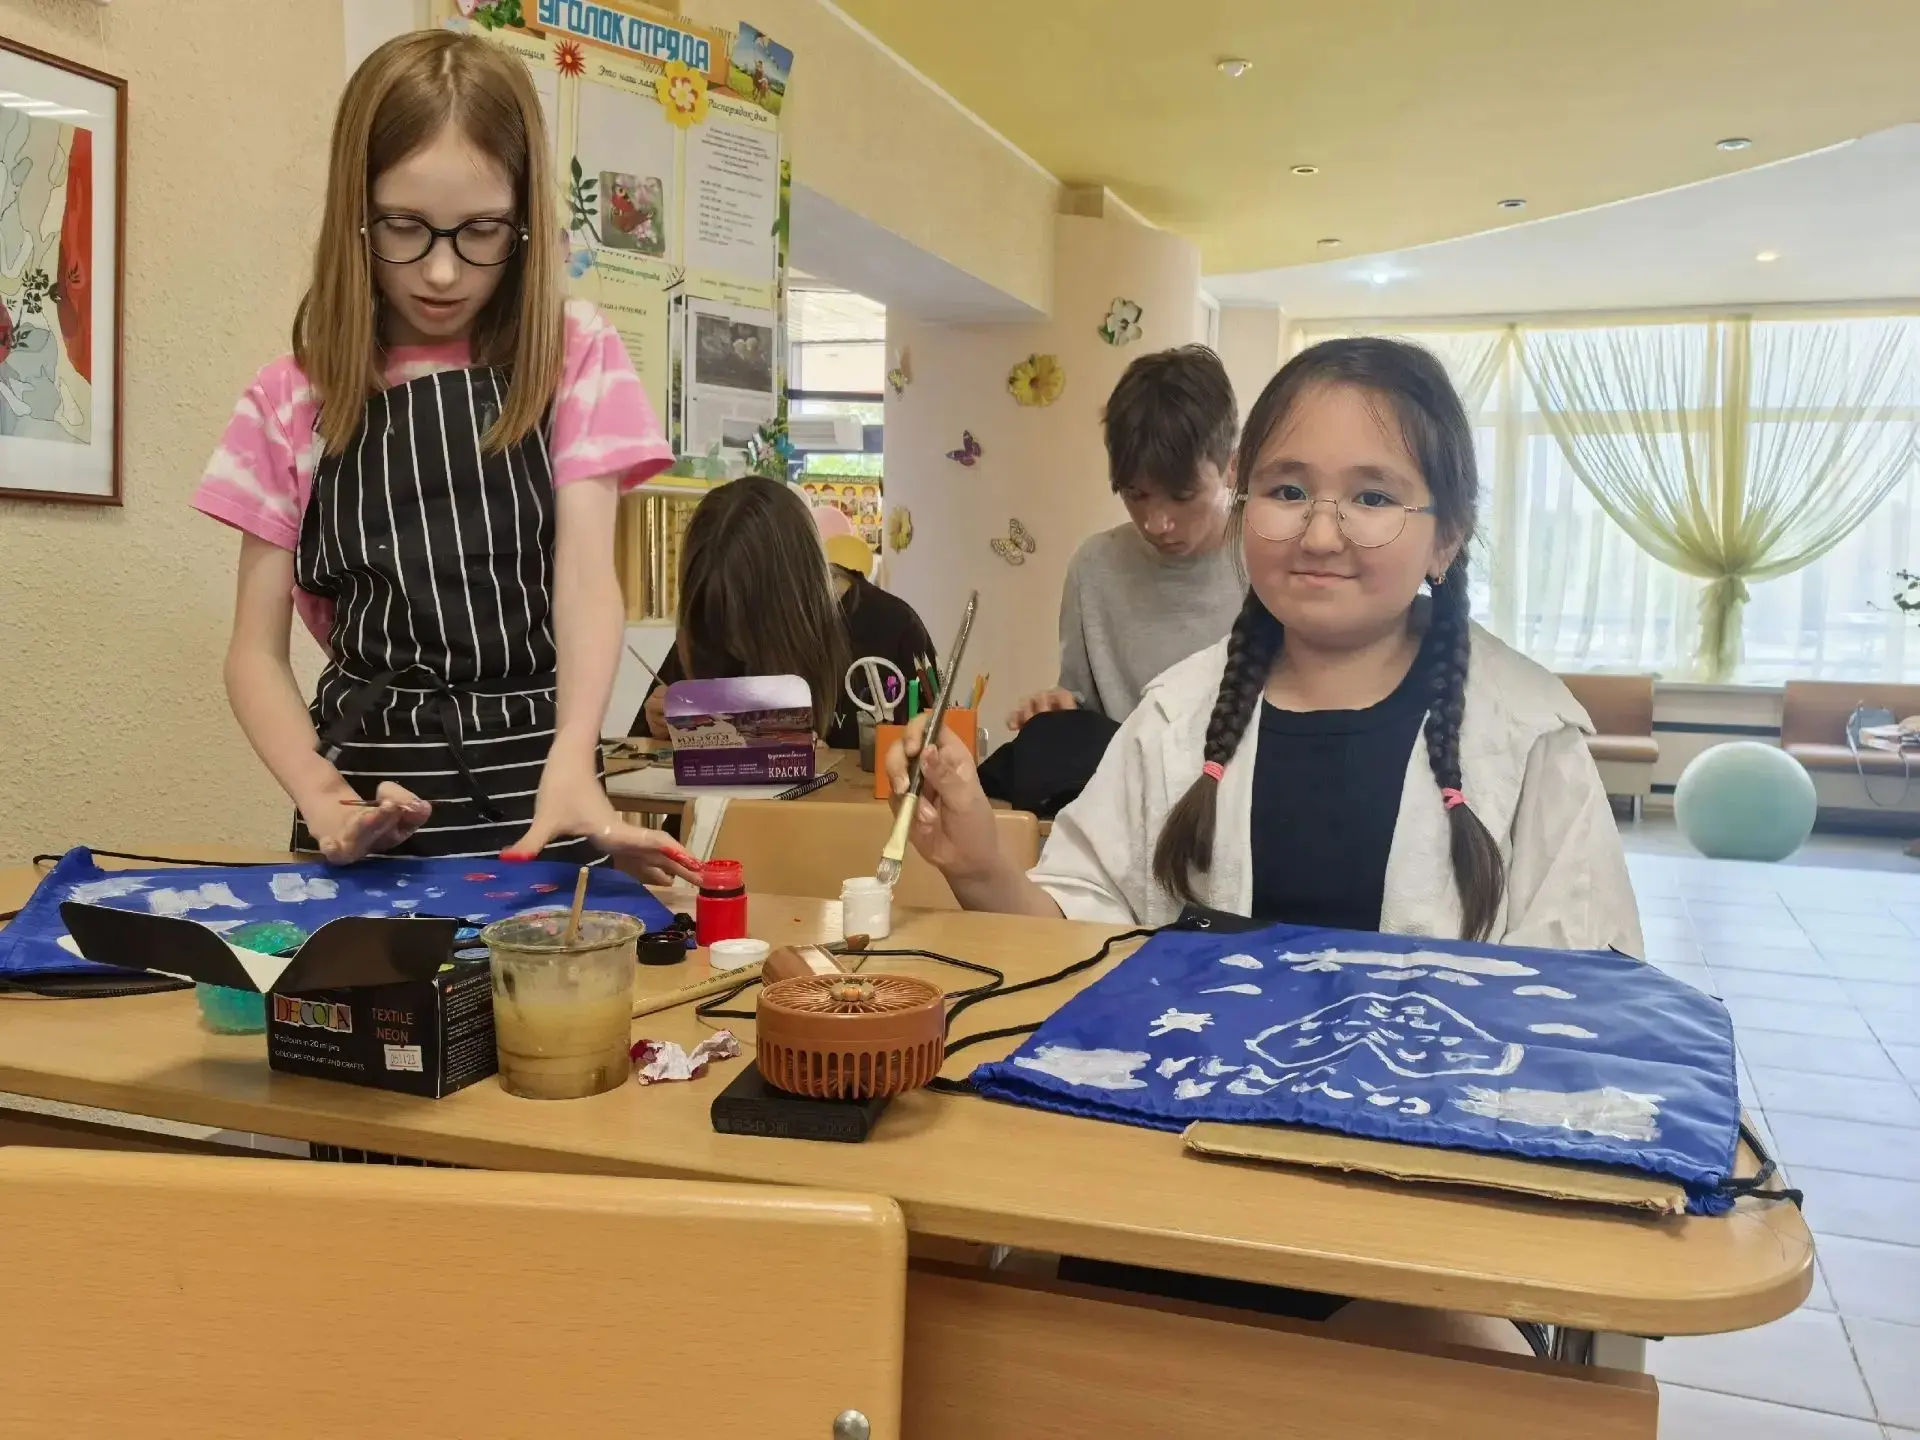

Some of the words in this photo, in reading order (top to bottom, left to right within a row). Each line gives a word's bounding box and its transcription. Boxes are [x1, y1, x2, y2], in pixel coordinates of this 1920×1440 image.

[538, 0, 626, 46] УГОЛОК
[628, 17, 709, 72] ОТРЯДА
[768, 765, 807, 778] КРАСКИ
[275, 994, 352, 1032] DECOLA
[371, 1007, 414, 1025] TEXTILE
[310, 1039, 319, 1048] 20
[376, 1027, 409, 1044] NEON
[274, 1049, 302, 1060] COLOURS
[303, 1053, 316, 1062] FOR
[316, 1056, 328, 1064] ART
[328, 1058, 341, 1067] AND
[341, 1061, 365, 1071] CRAFTS
